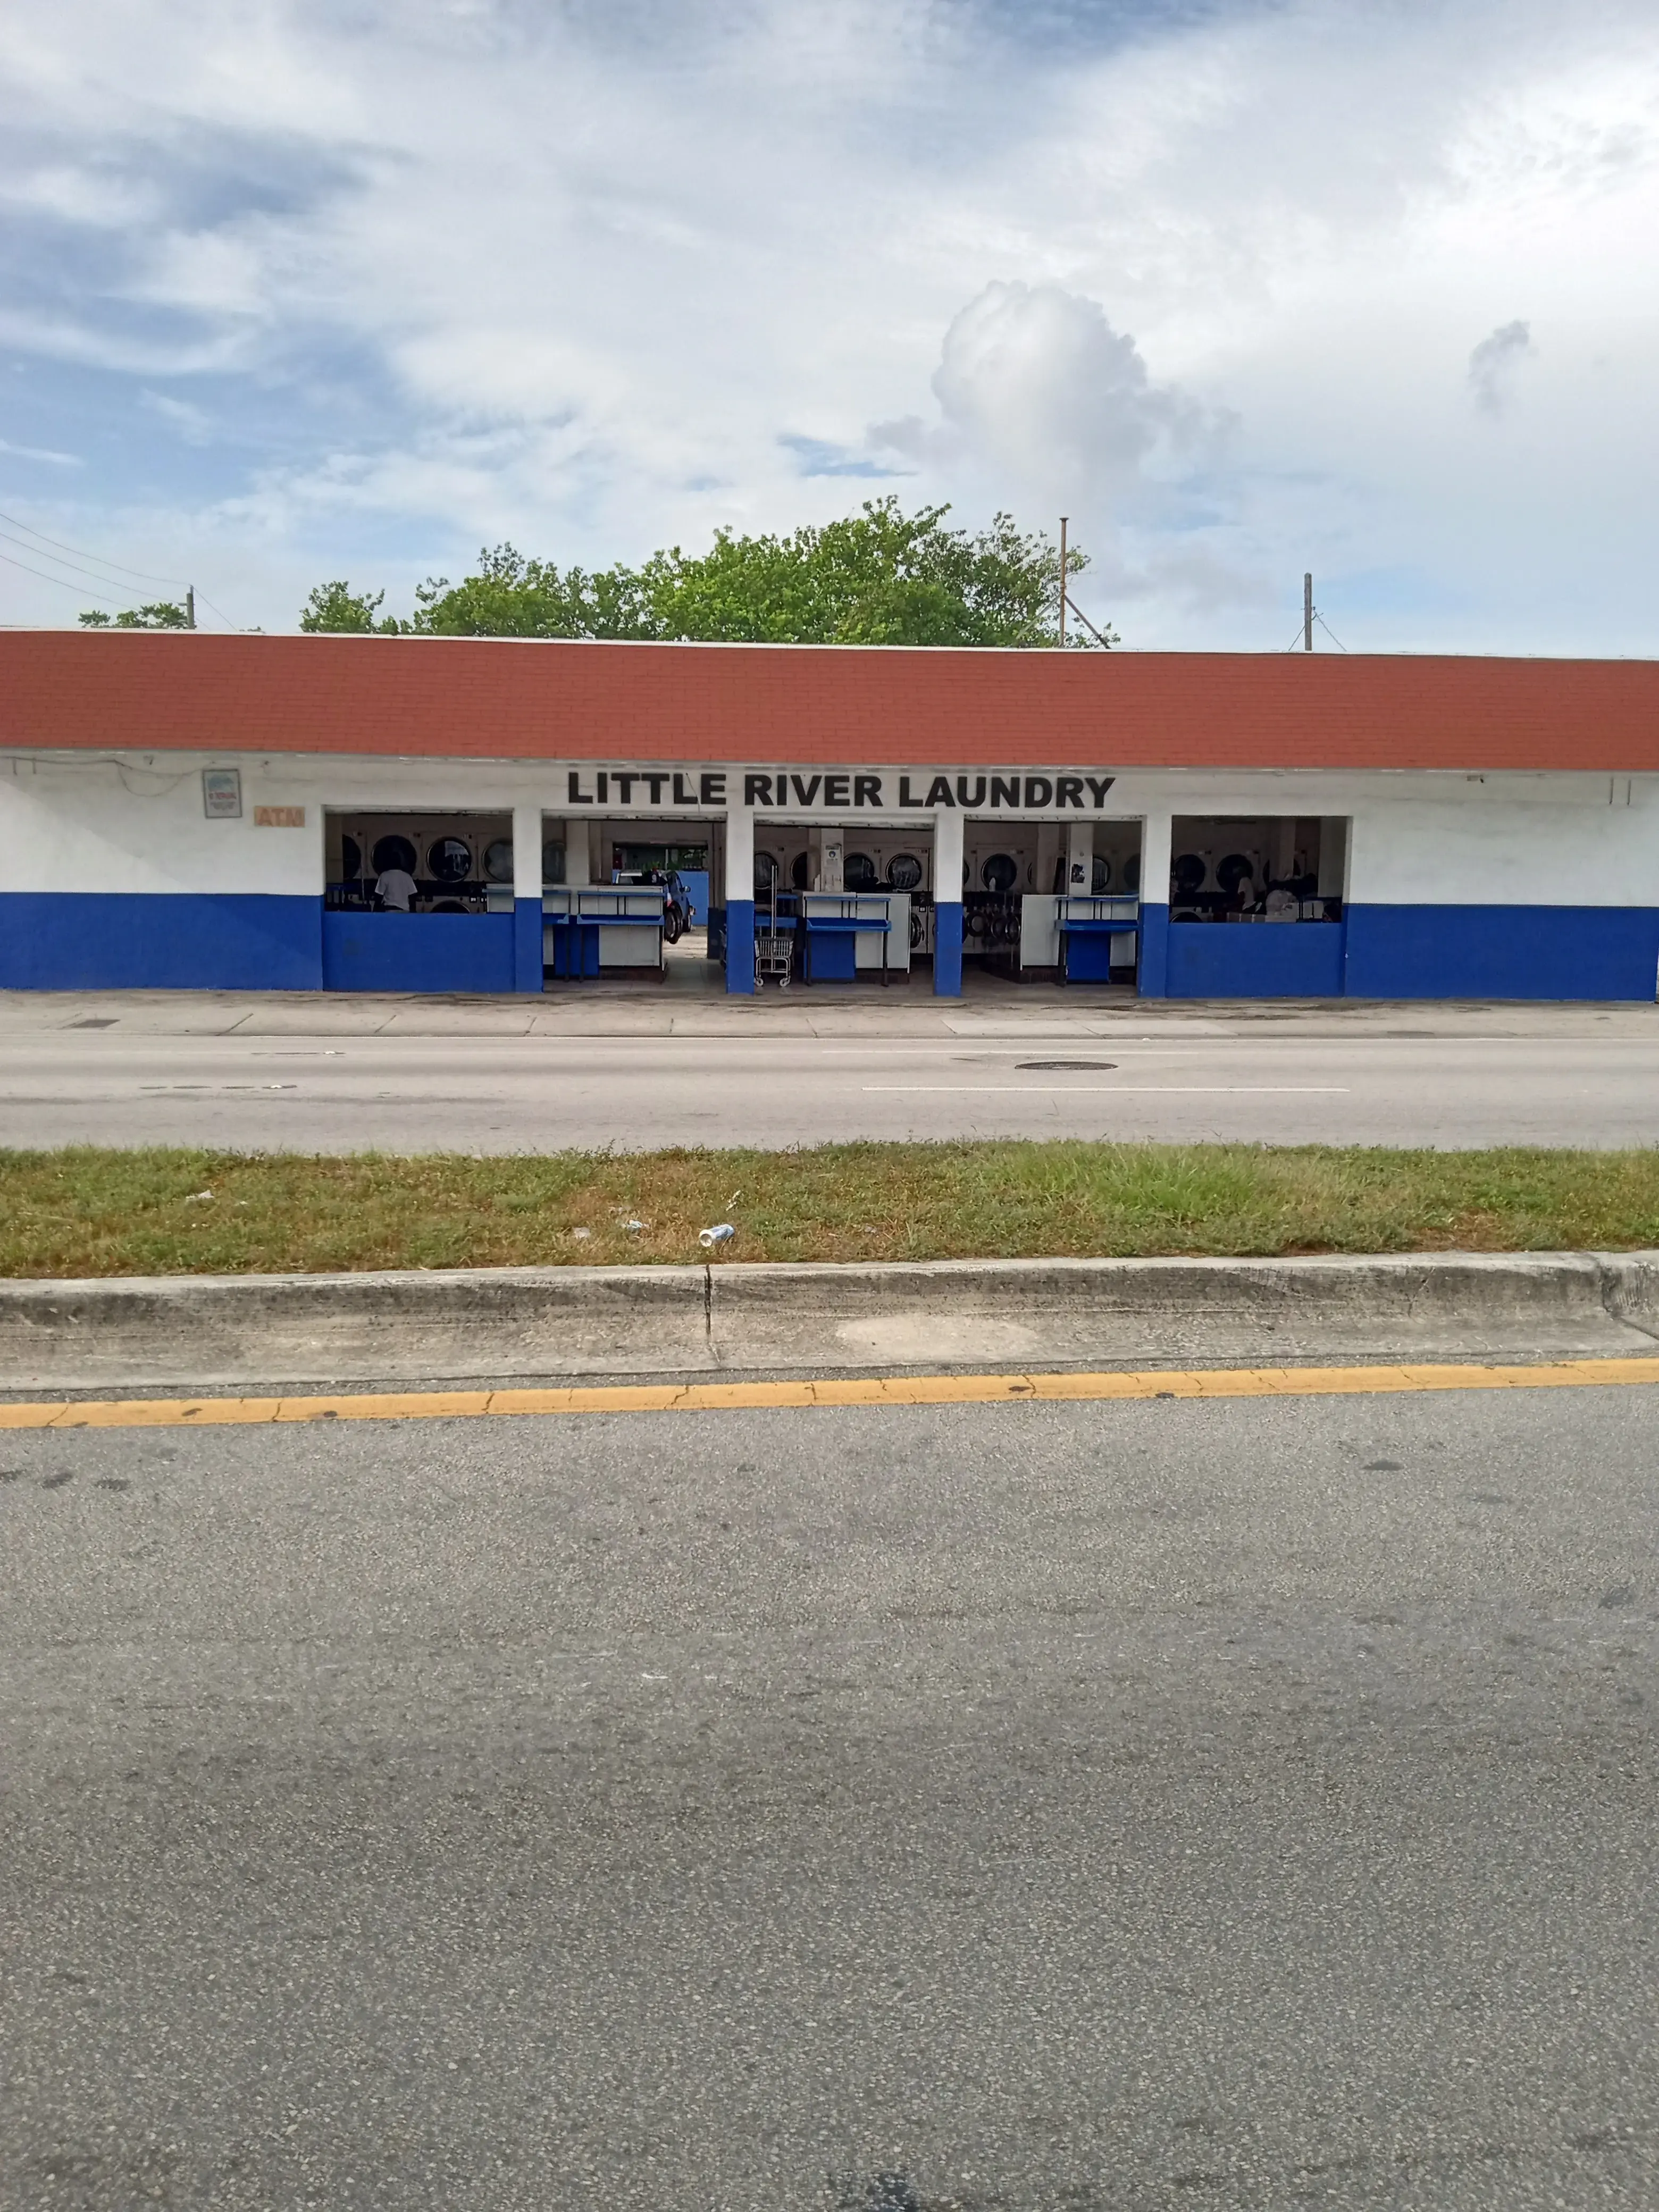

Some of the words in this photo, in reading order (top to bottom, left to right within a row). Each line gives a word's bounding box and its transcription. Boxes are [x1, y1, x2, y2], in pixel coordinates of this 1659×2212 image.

[568, 772, 727, 805] LITTLE
[744, 774, 883, 807] RIVER
[899, 776, 1116, 808] LAUNDRY
[257, 808, 303, 827] ATM
